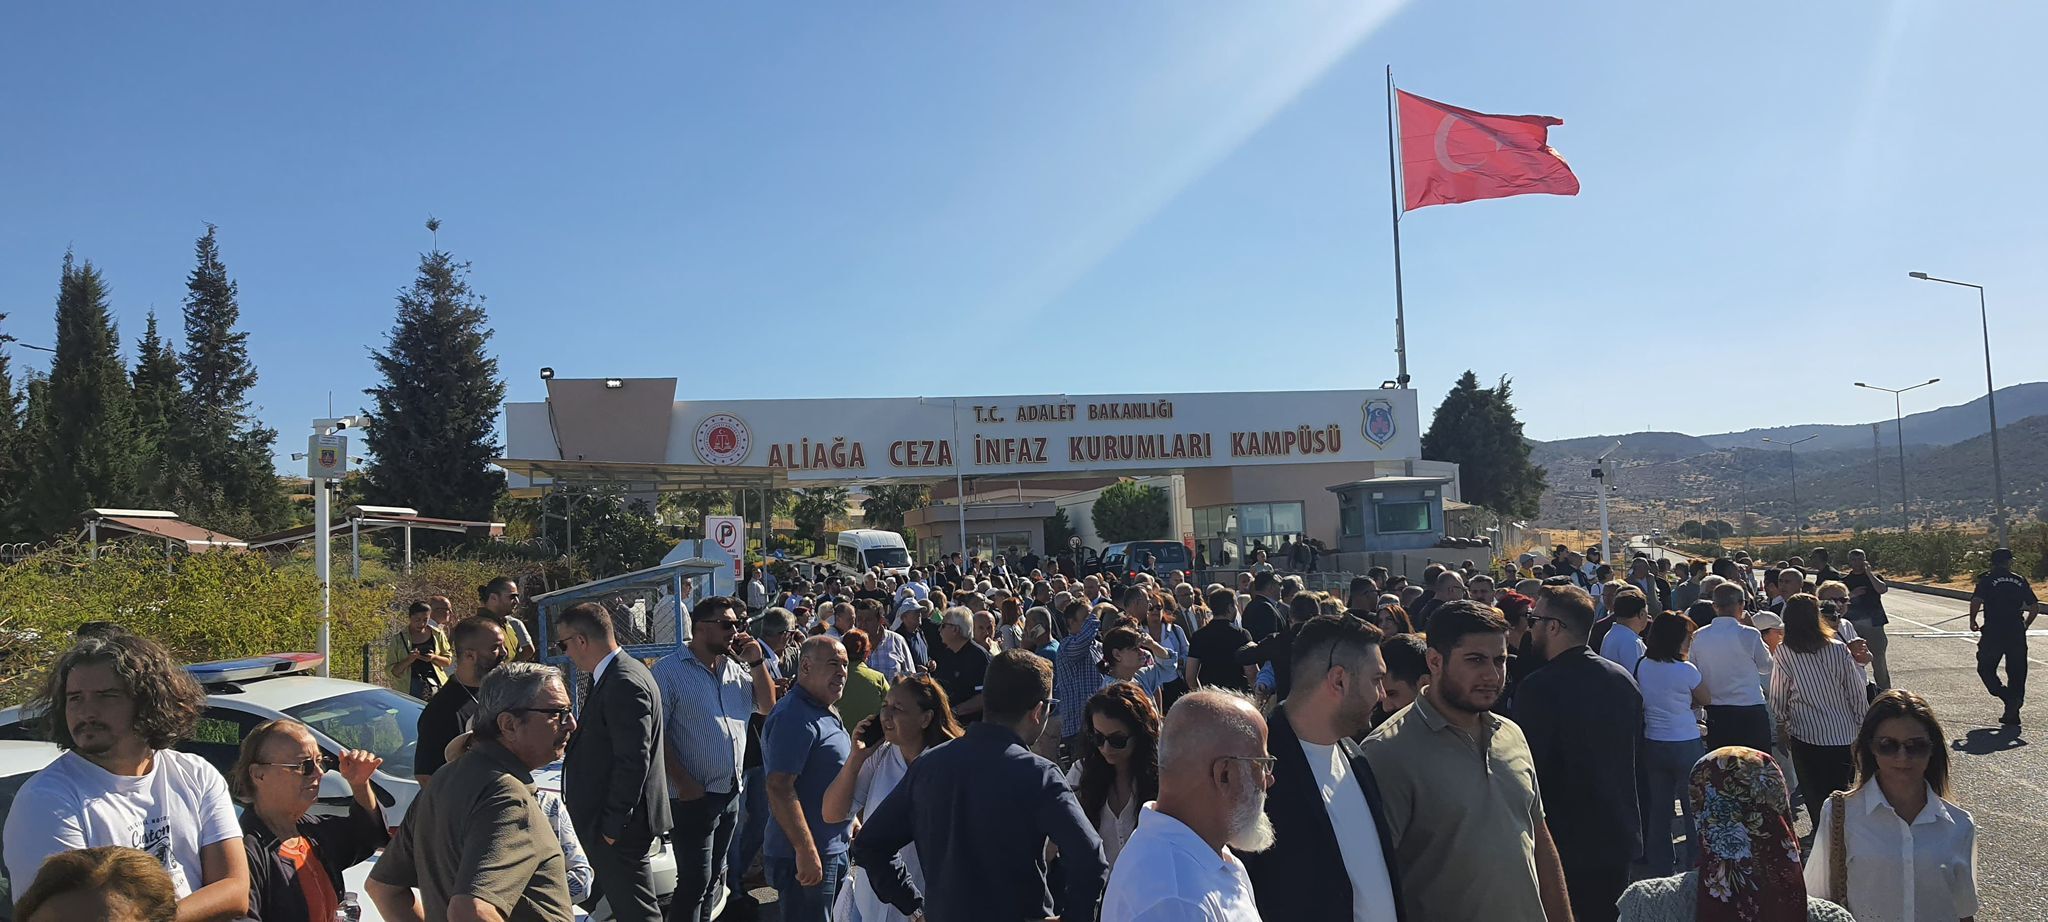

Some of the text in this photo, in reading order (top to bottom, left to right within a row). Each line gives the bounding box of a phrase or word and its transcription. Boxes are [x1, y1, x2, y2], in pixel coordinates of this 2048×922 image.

[973, 399, 1174, 422] T.C. ADALET BAKANLIĞI
[767, 436, 867, 469] ALİAĞA
[888, 438, 955, 467] CEZA
[974, 432, 1049, 465] İNFAZ
[1068, 432, 1212, 462] KURUMLARI
[1231, 423, 1342, 457] KAMPÜSÜ
